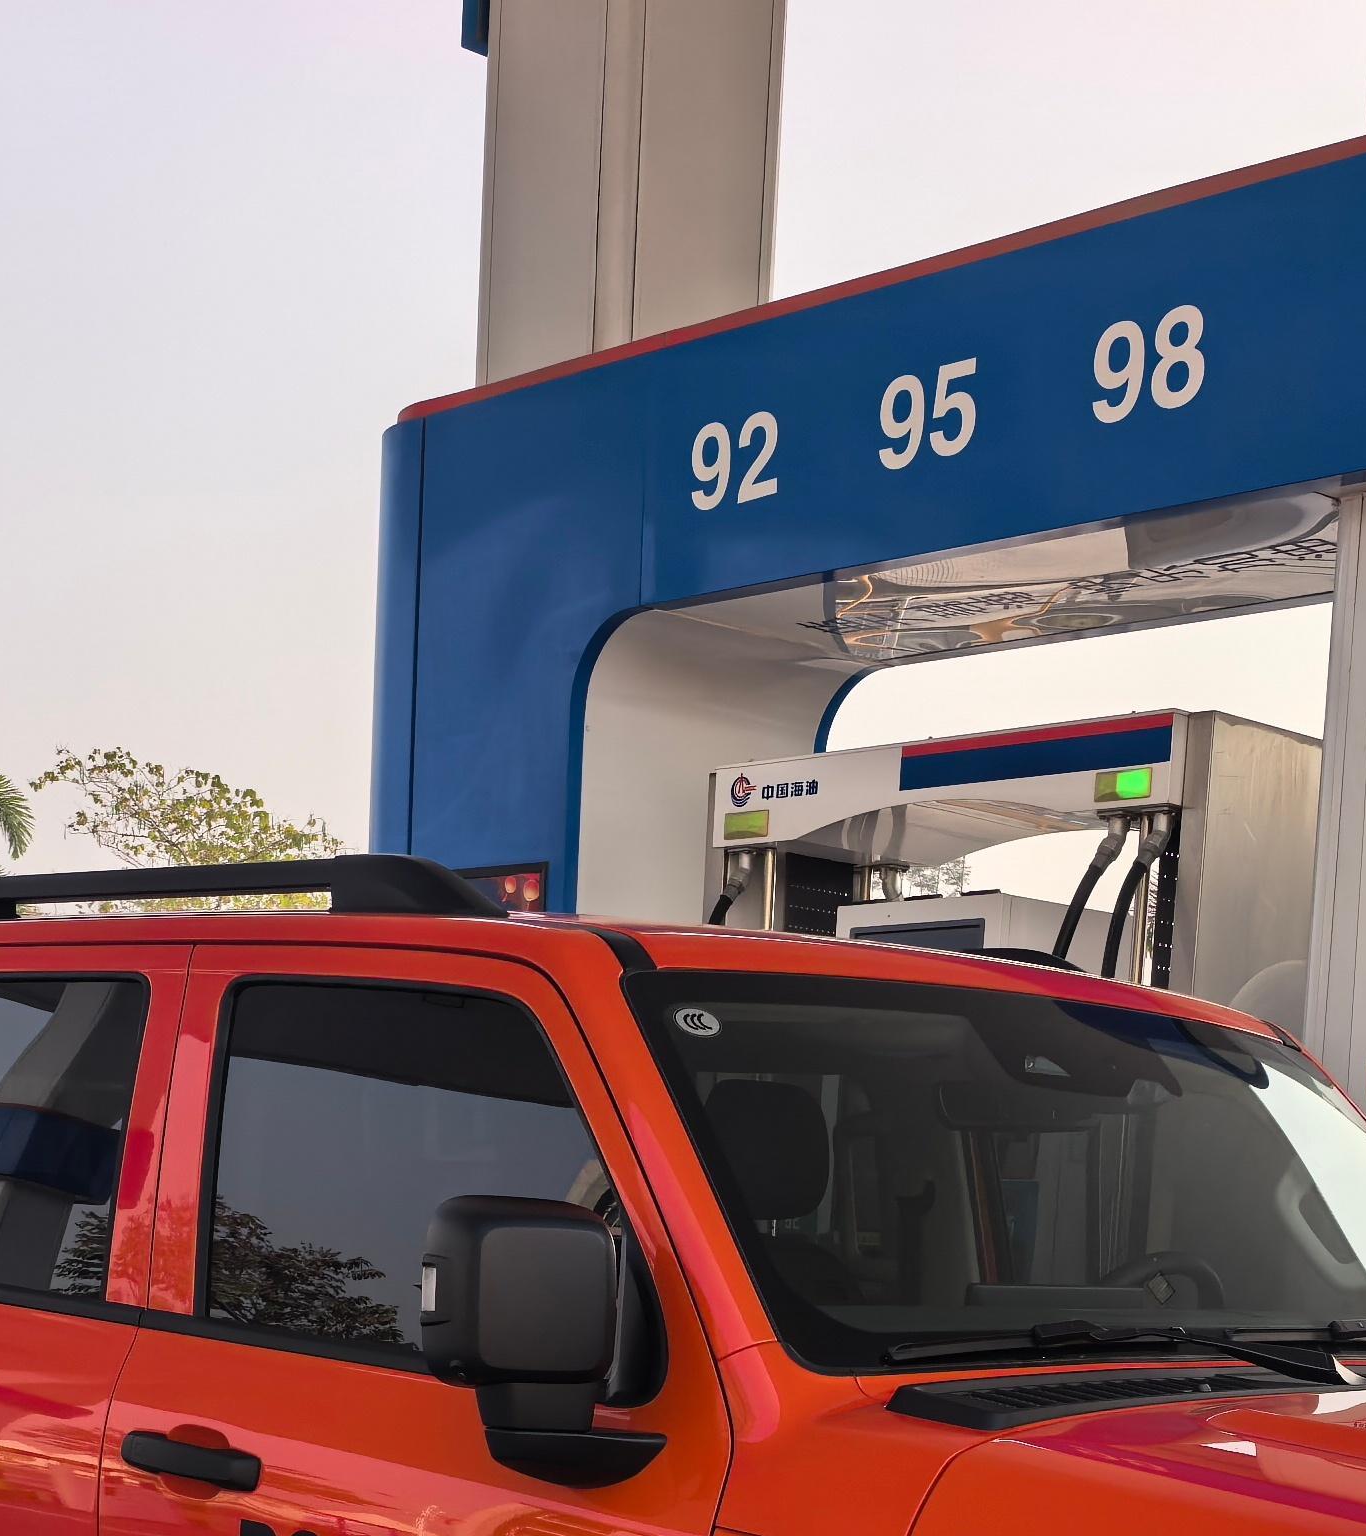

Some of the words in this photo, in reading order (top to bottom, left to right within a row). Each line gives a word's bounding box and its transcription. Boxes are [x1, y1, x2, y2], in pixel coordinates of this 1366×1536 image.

[691, 411, 778, 511] 92
[878, 357, 976, 470] 95
[1091, 304, 1204, 424] 98
[761, 779, 818, 801] 中国海油
